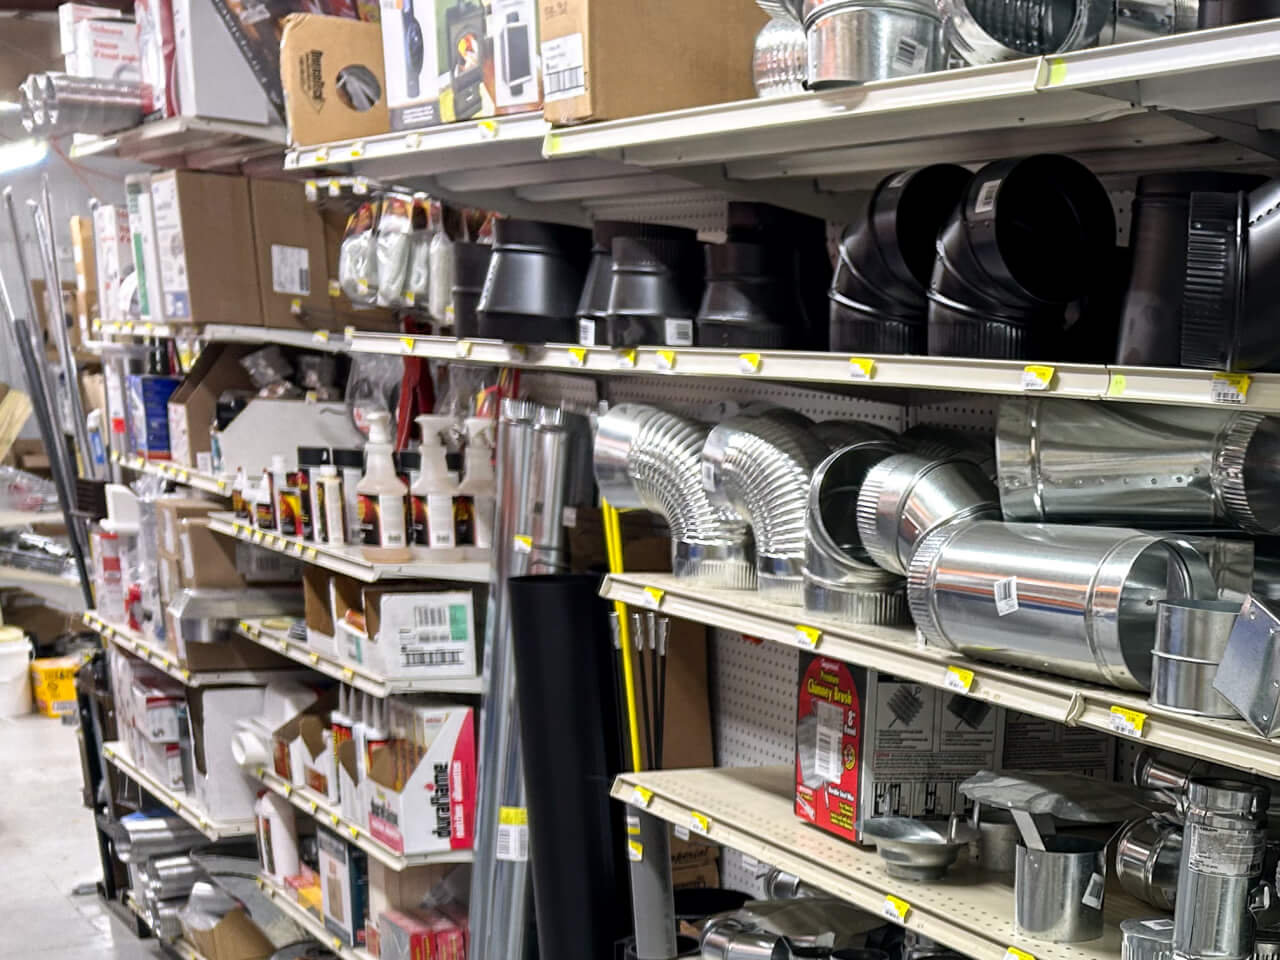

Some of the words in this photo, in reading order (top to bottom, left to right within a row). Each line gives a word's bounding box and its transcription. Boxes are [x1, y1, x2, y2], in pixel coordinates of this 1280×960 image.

[807, 678, 832, 701] Chimney
[834, 687, 852, 705] Brush
[430, 761, 451, 838] duraflame
